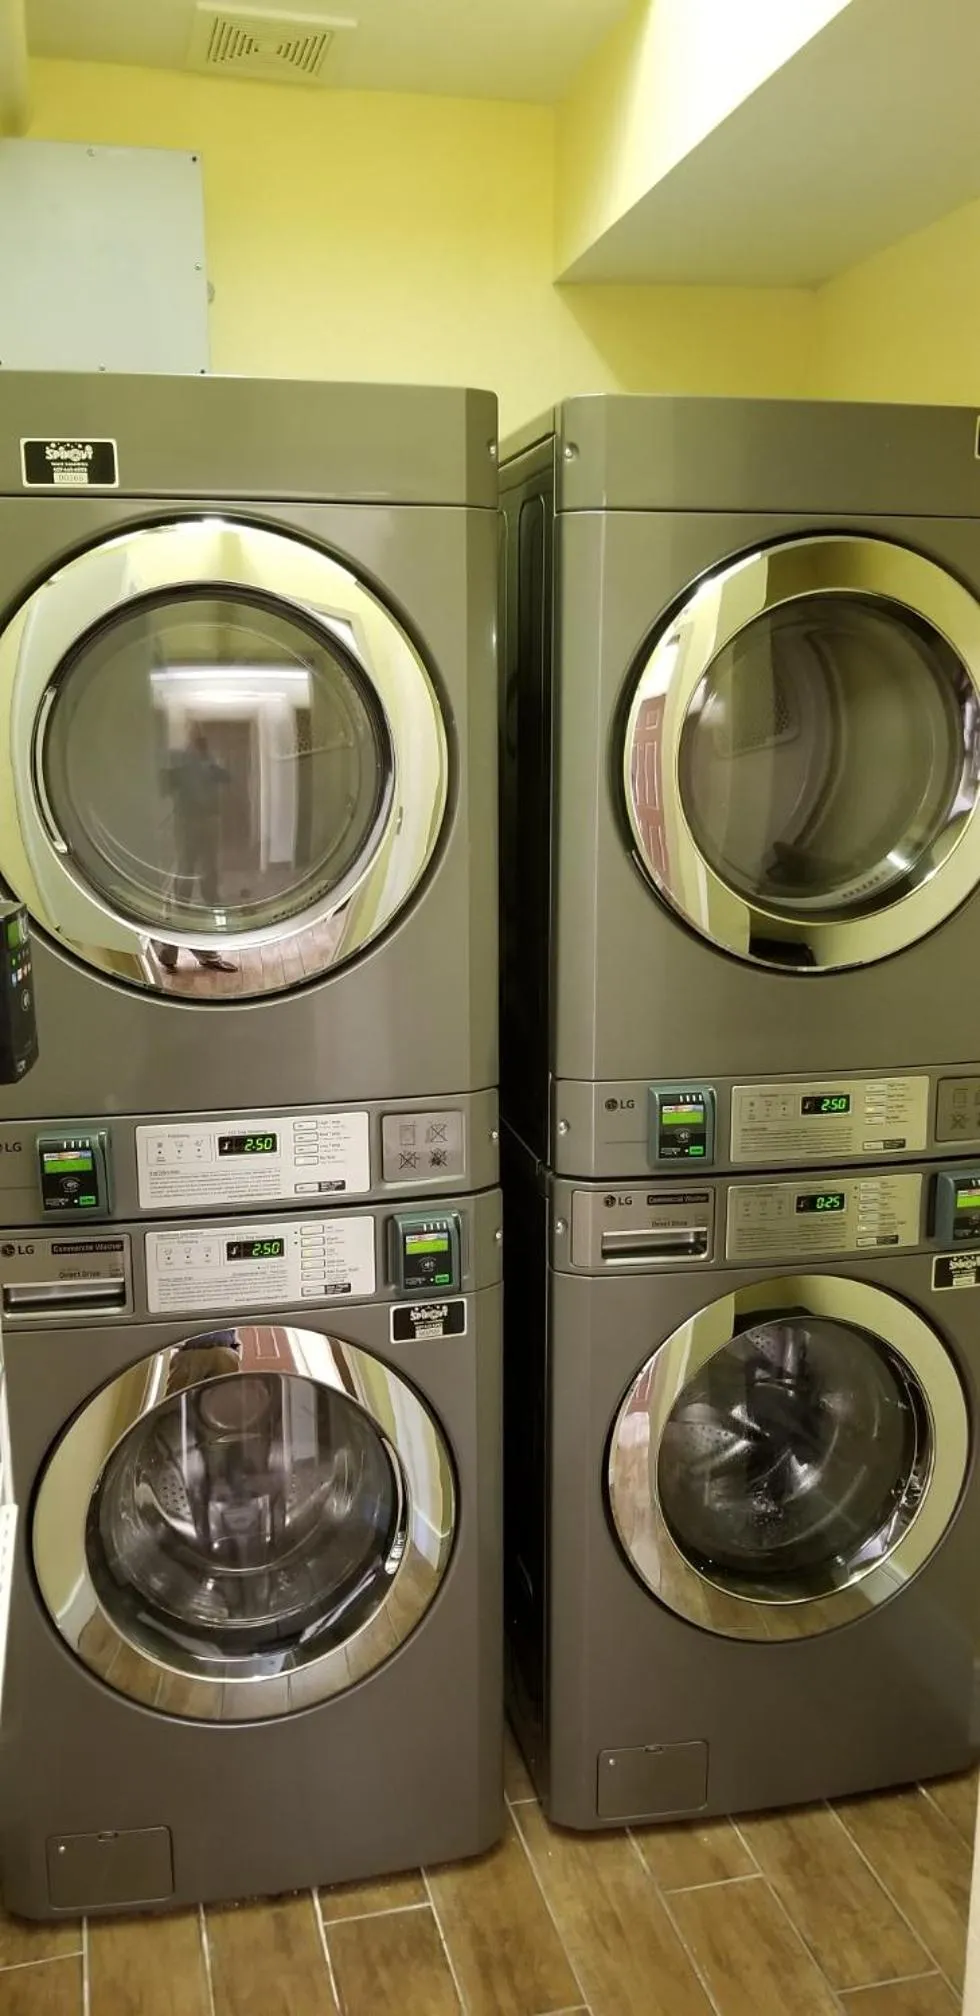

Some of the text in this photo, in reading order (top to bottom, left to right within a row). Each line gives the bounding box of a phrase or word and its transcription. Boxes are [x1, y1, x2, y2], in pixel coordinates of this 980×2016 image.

[820, 1098, 846, 1110] 2.50
[5, 1142, 22, 1152] LG
[244, 1138, 272, 1151] 2.50
[252, 1241, 280, 1256] 2.50
